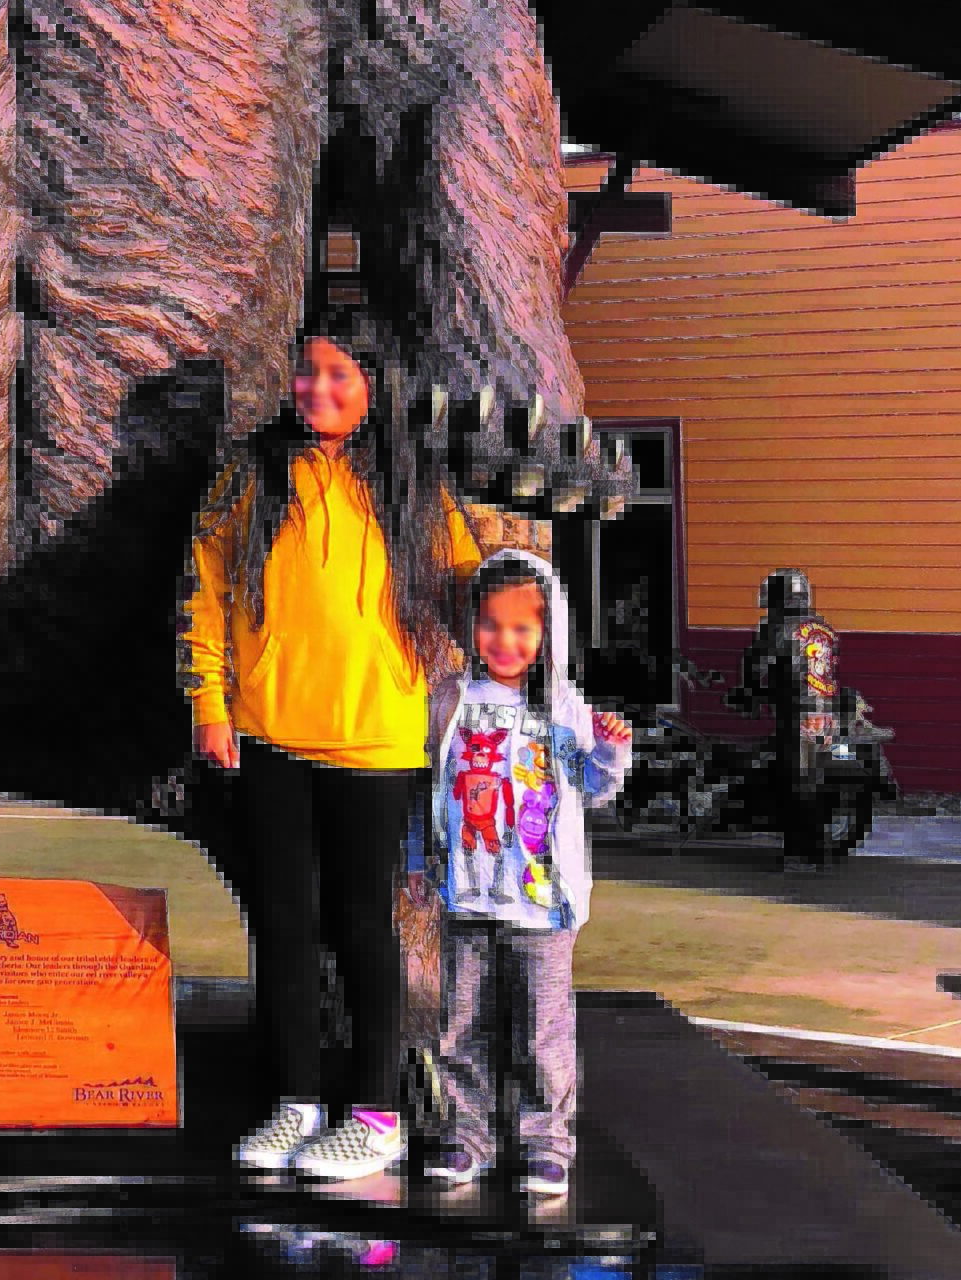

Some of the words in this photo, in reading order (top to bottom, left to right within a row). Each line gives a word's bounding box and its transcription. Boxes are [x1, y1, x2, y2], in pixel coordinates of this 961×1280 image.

[76, 954, 97, 962] tribal
[72, 963, 103, 971] through
[74, 1088, 114, 1101] BEAR
[119, 1088, 164, 1102] RIVER
